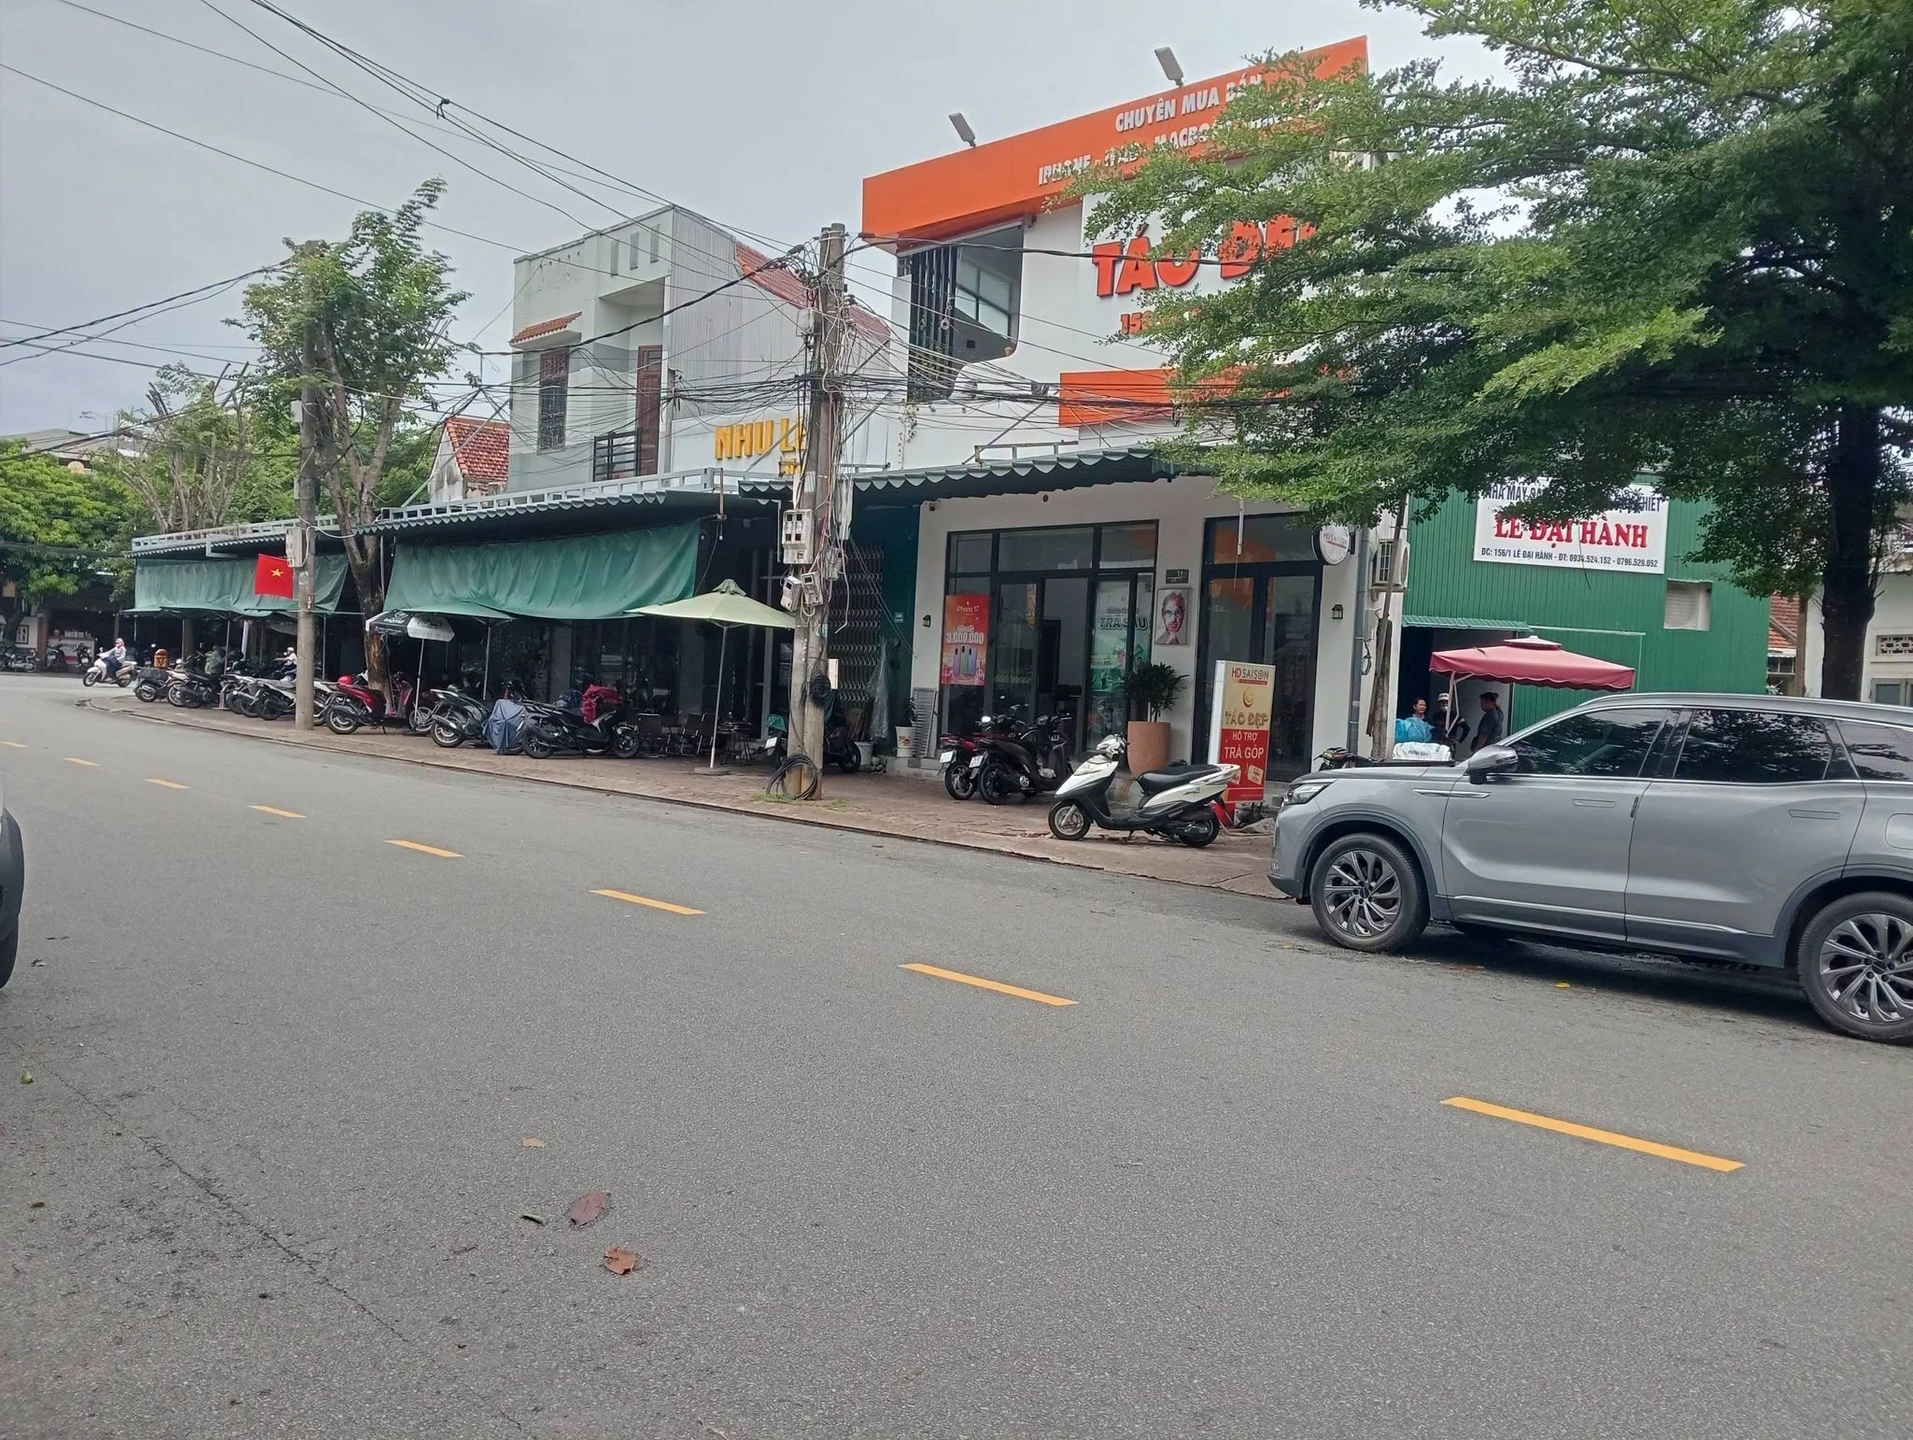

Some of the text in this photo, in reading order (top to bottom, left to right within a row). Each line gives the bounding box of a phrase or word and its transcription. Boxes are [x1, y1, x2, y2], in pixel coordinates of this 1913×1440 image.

[1115, 97, 1177, 133] CHUYÊN
[1181, 86, 1220, 116] MUA
[1244, 743, 1264, 759] GÓP
